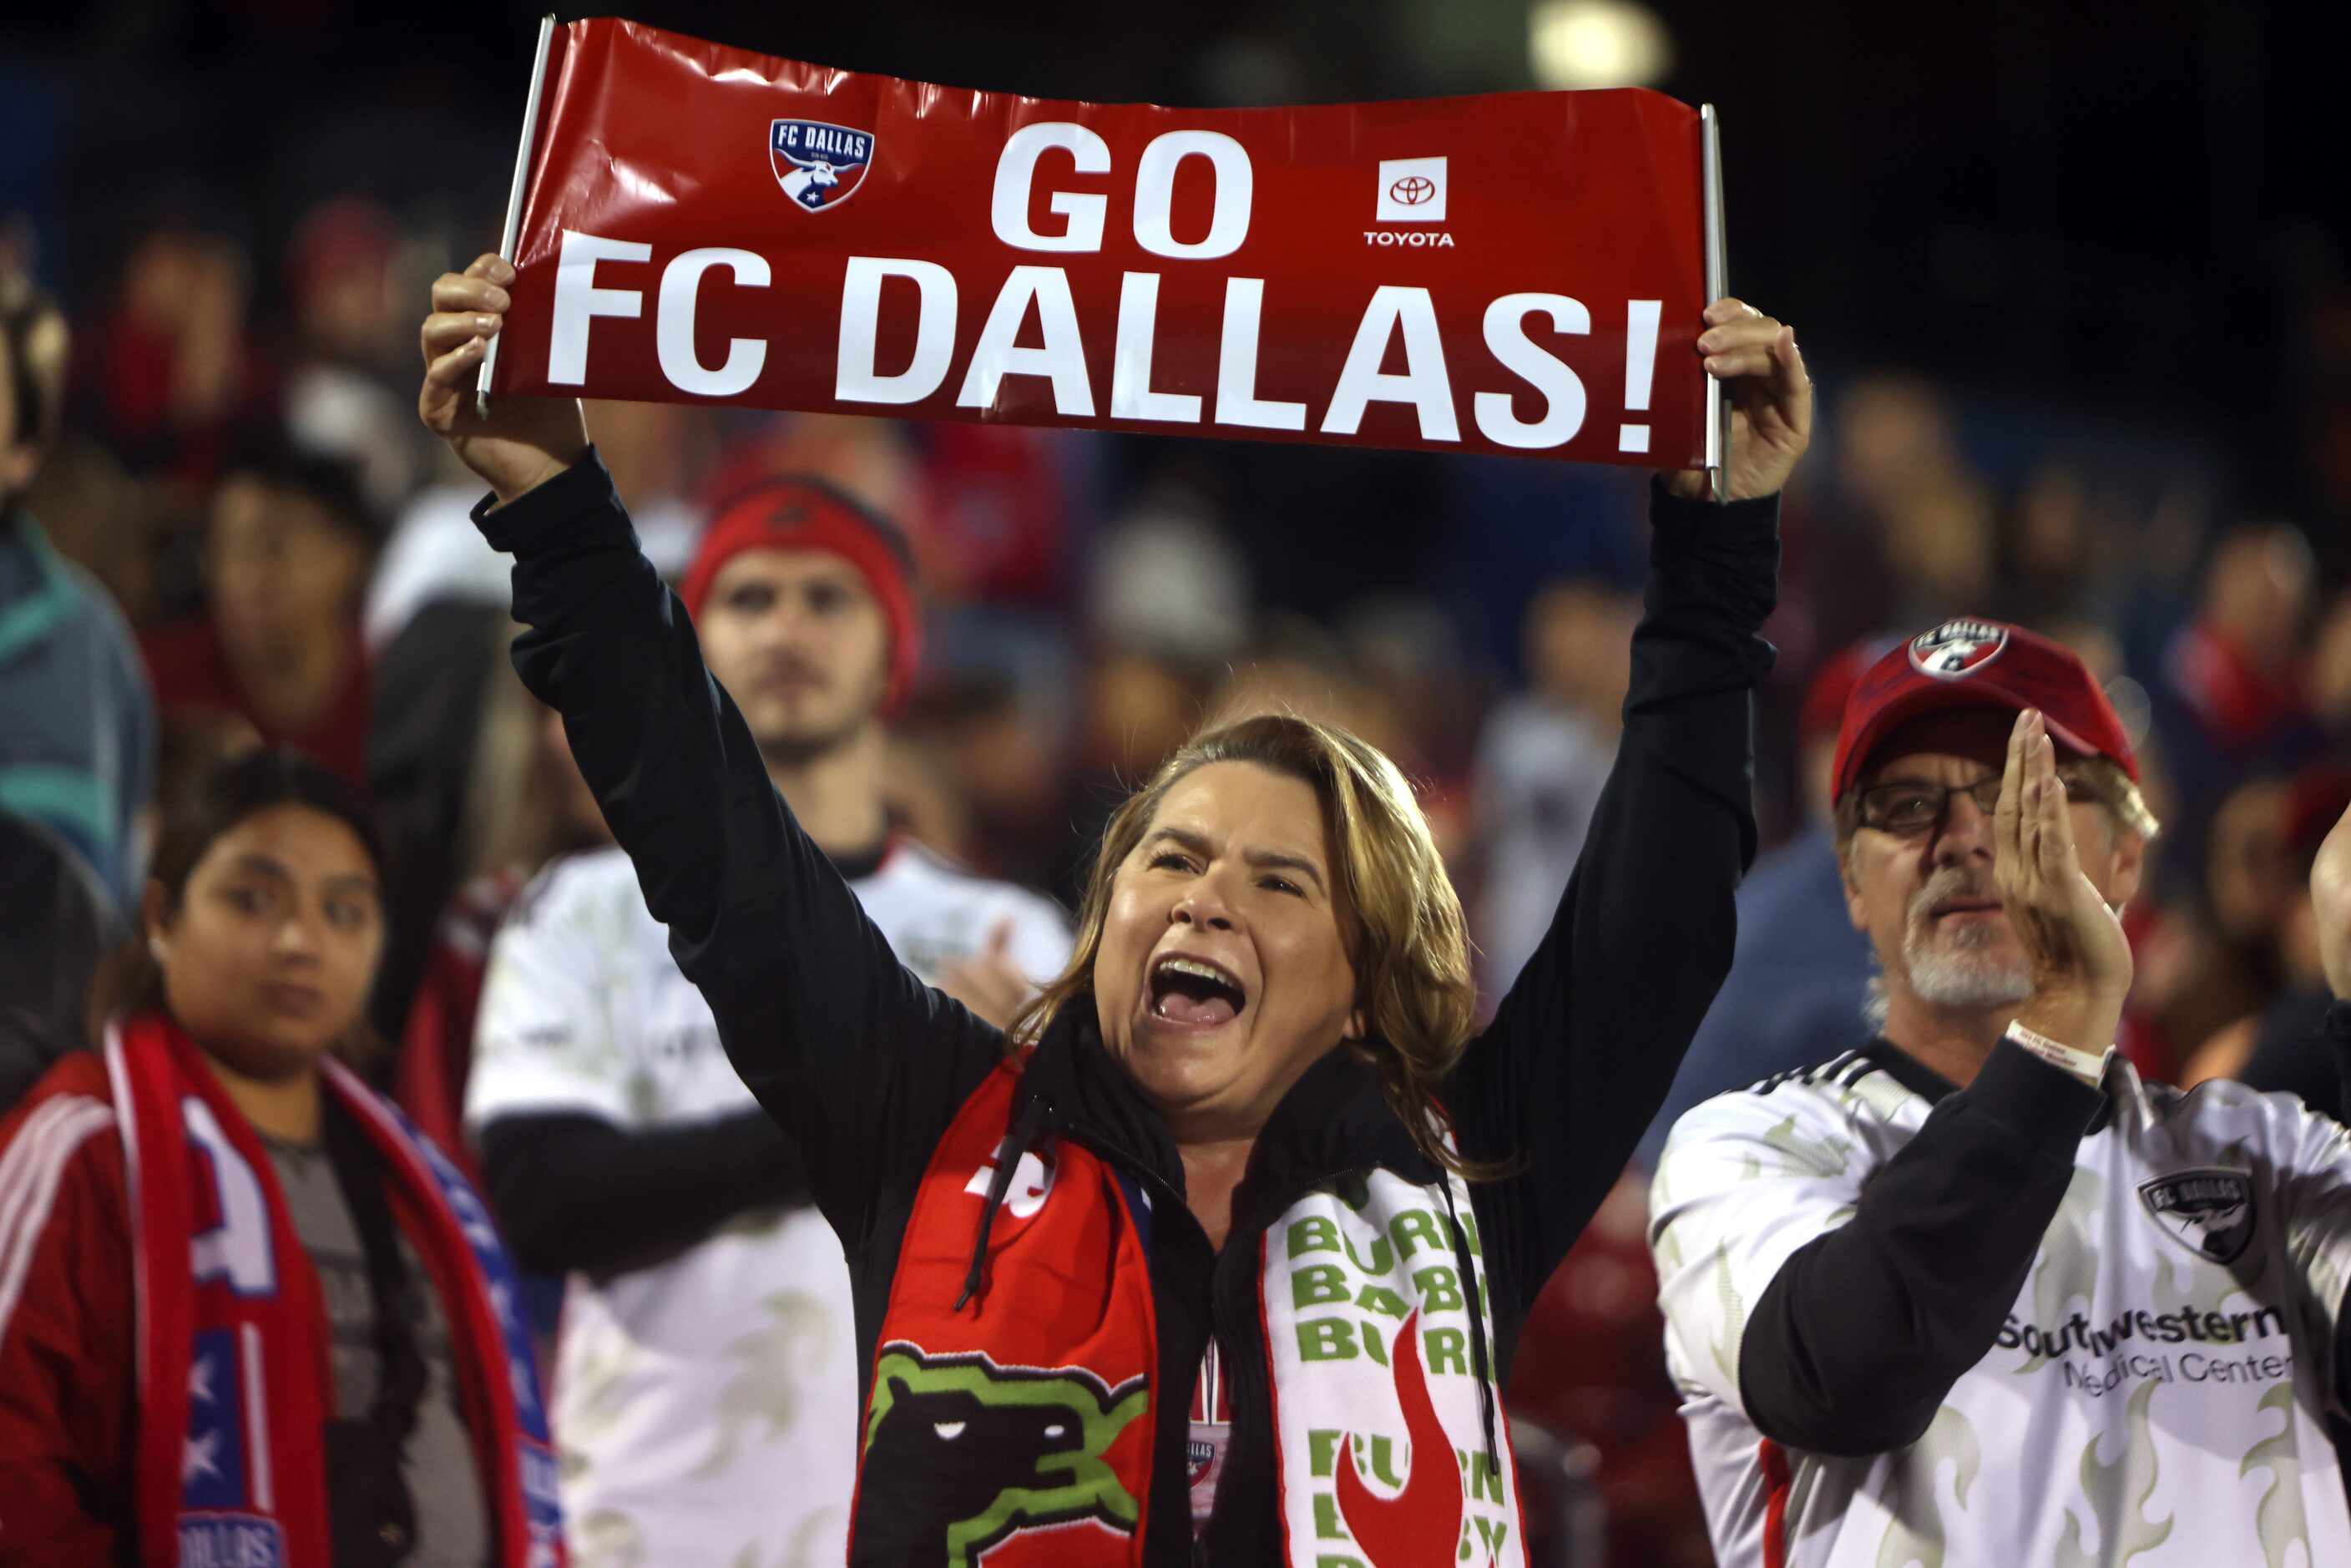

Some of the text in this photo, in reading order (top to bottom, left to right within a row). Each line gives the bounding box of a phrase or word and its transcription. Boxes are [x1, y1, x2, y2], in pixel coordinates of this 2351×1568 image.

[778, 124, 866, 160] FC DALLAS
[991, 122, 1253, 260] GO
[1363, 231, 1455, 248] TOYOTA
[547, 229, 1663, 453] FC DALLAS!
[1287, 1208, 1483, 1276] BURN
[1187, 1442, 1212, 1459] LLAS
[1308, 1429, 1504, 1508] BUN
